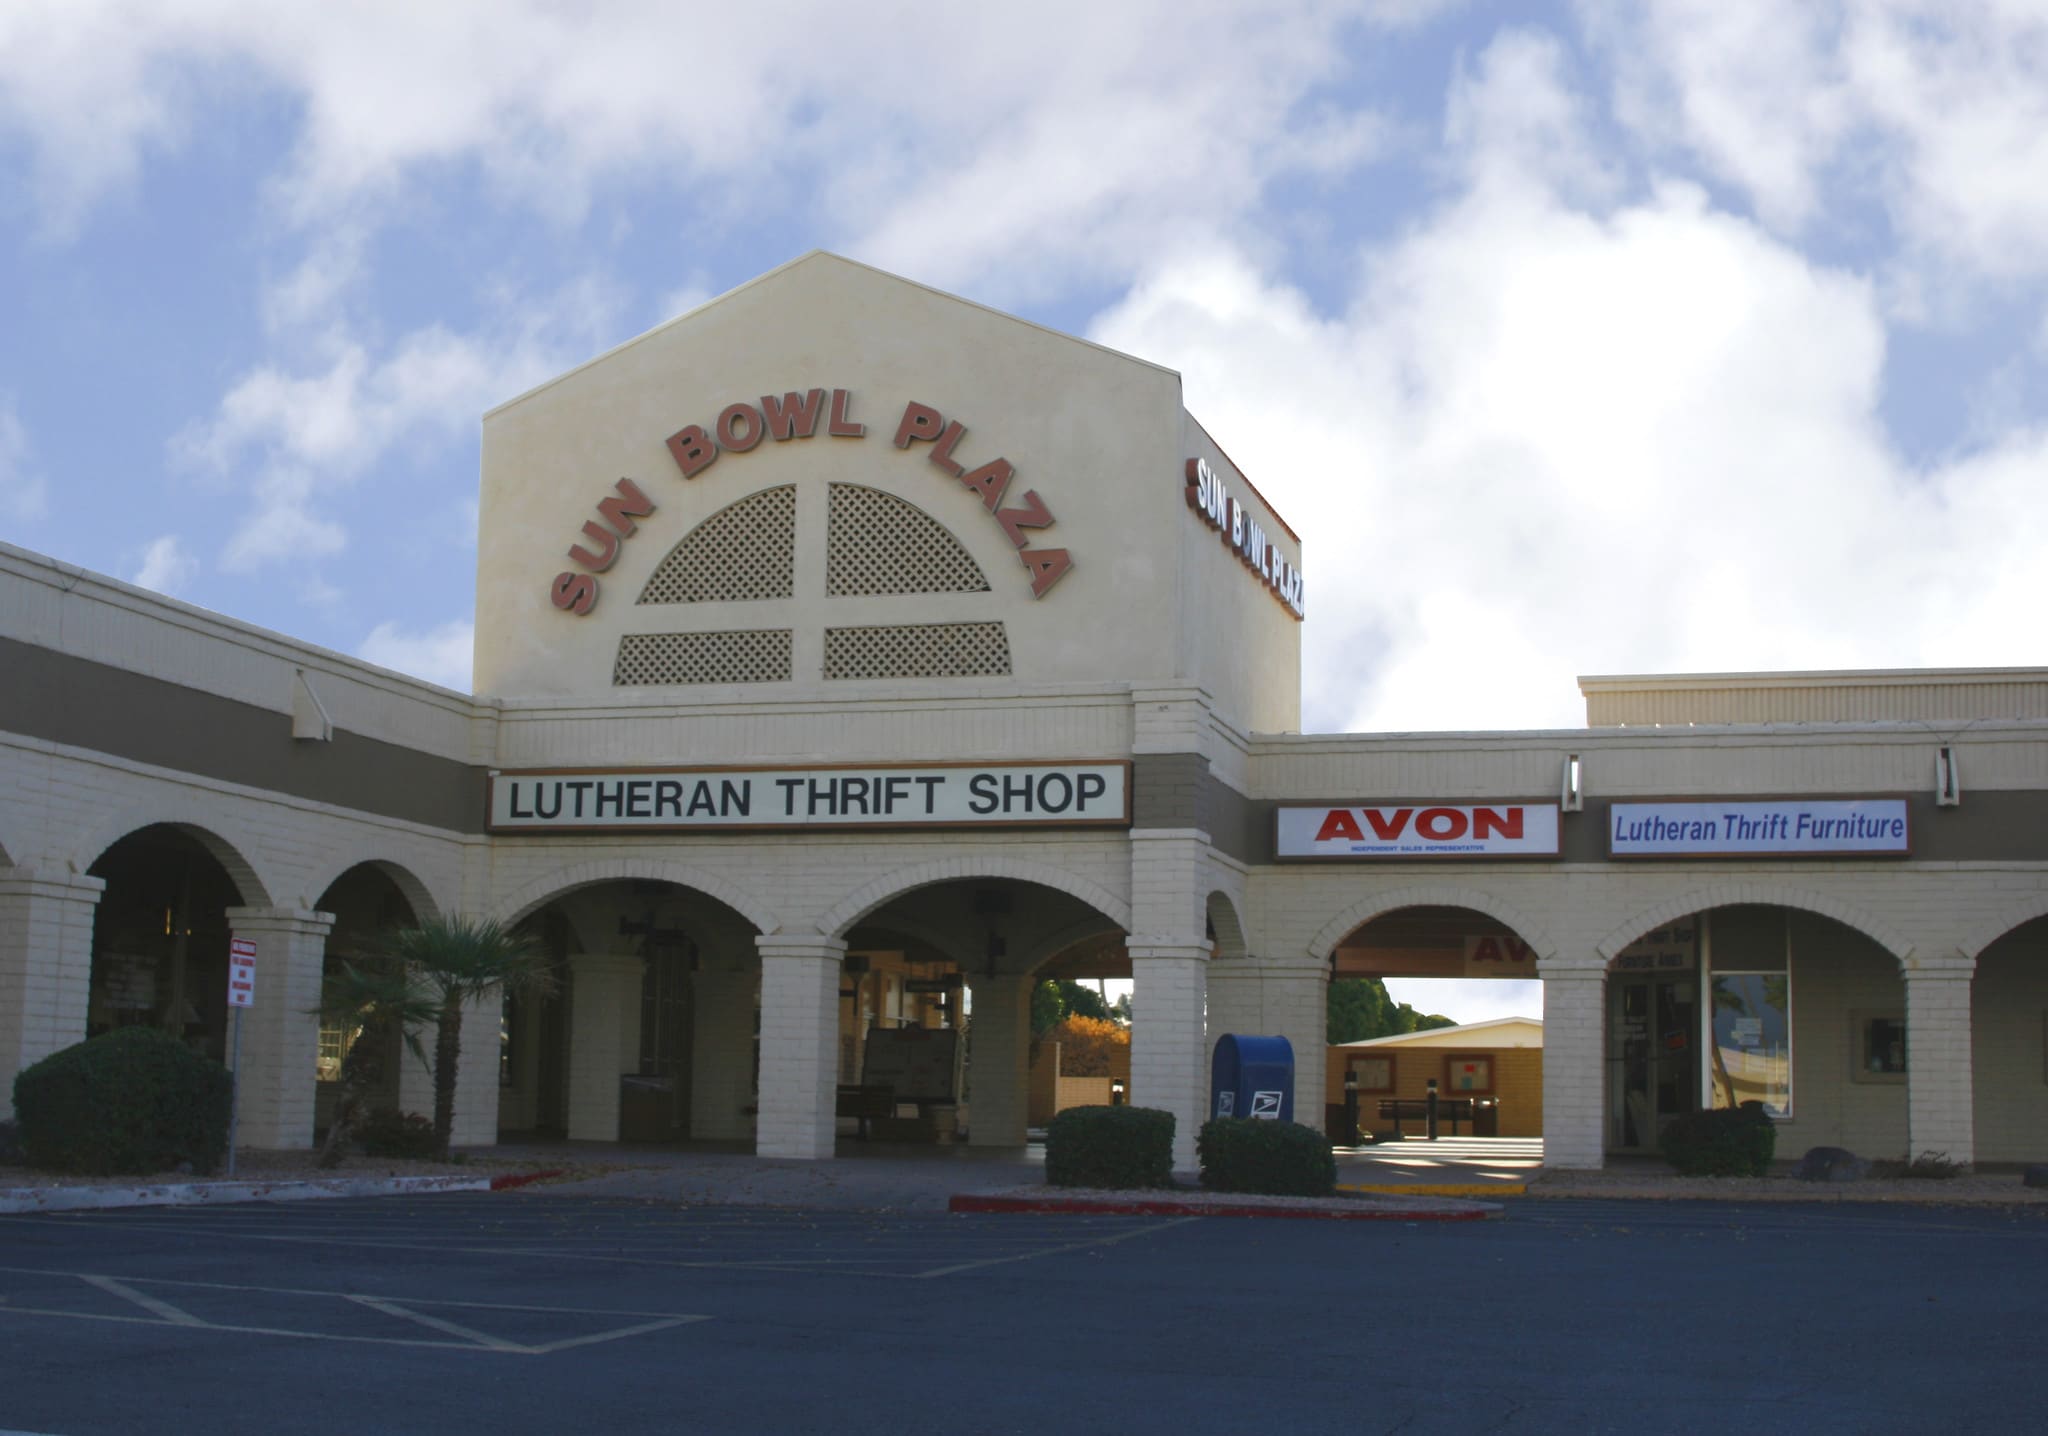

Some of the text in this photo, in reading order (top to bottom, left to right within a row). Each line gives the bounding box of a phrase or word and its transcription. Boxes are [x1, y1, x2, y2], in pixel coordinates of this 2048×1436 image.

[551, 388, 1075, 616] SUN BOWL PLAZA
[1189, 457, 1227, 533] SUN
[1232, 497, 1270, 580] BOWL
[510, 773, 1106, 819] LUTHERAN THRIFT SHOP
[1314, 808, 1523, 841] AVON
[1615, 813, 1904, 841] Lutheran Thrift Furniture
